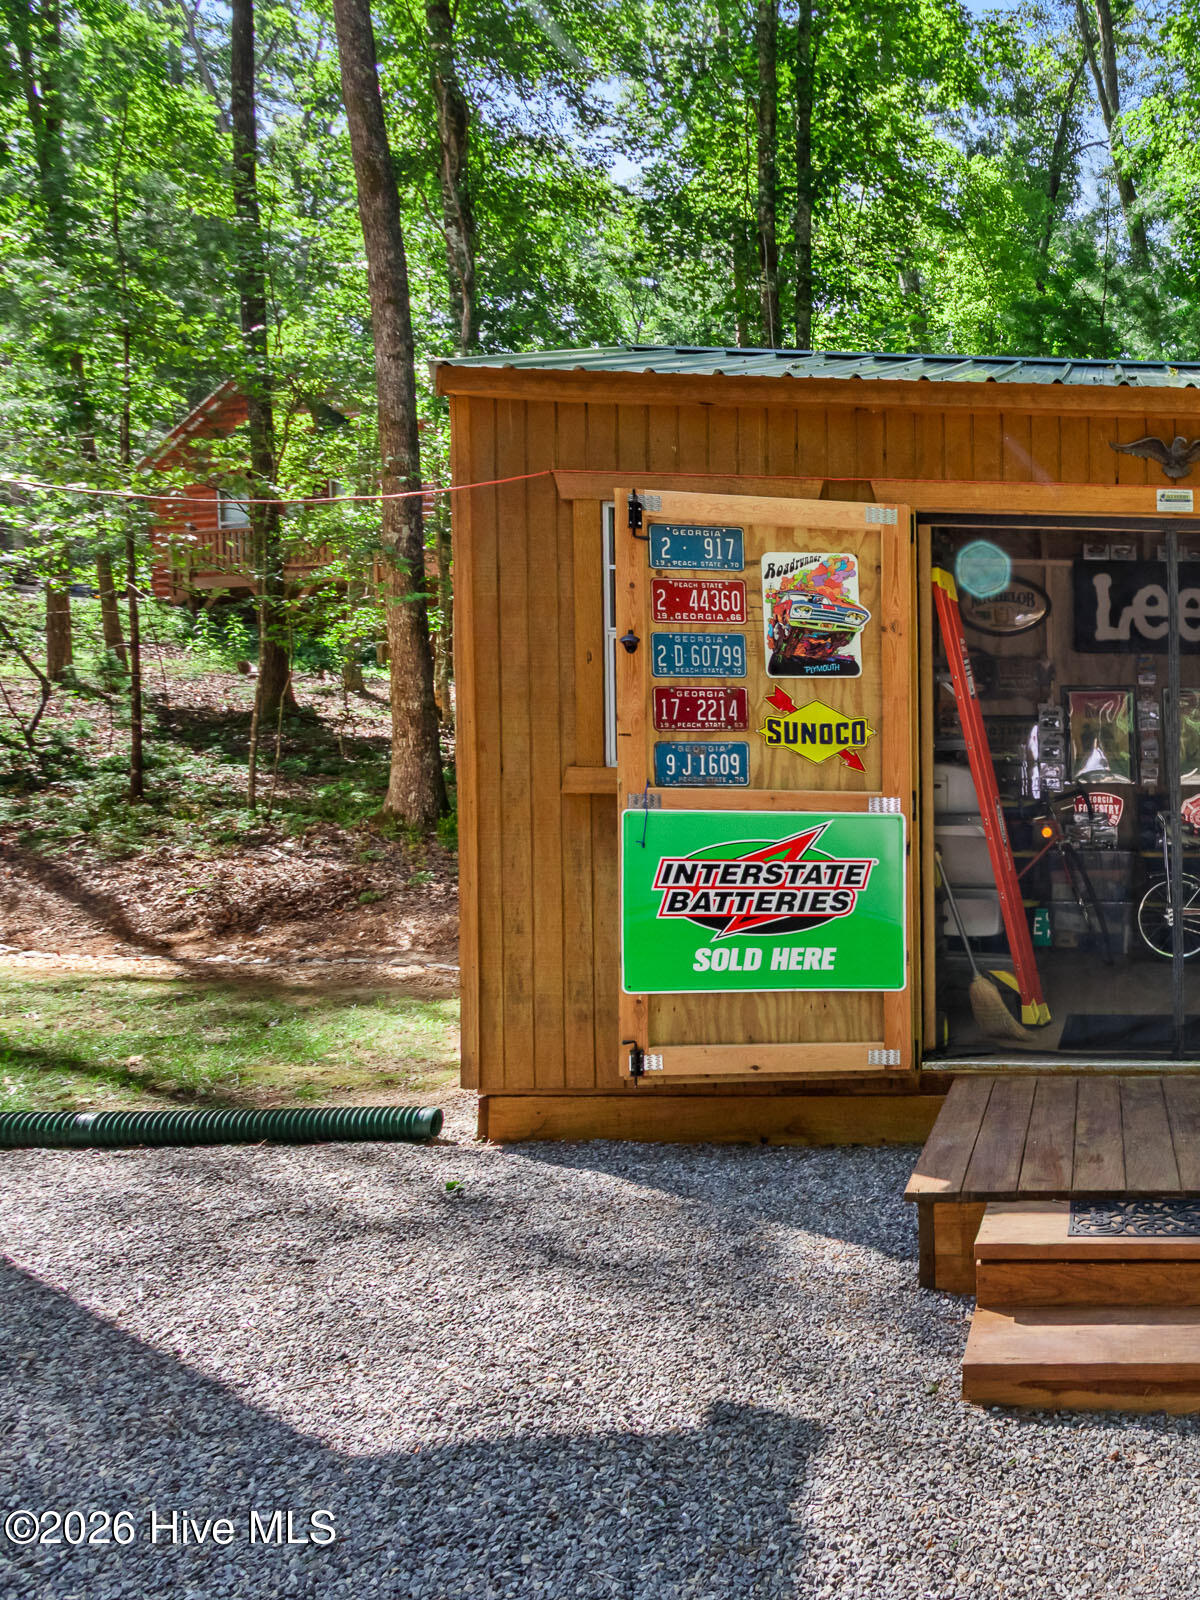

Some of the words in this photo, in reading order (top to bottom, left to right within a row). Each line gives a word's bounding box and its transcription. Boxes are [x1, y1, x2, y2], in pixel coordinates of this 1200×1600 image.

[672, 528, 721, 537] GEORGIA
[704, 538, 734, 560] 917
[764, 555, 822, 579] Roadrunner
[689, 589, 741, 612] 44360
[675, 612, 723, 620] GEORGIA
[730, 613, 742, 621] 66
[674, 635, 723, 643] GEORGIA
[803, 663, 841, 674] PLYMOUTH
[676, 690, 726, 698] GEORGIA
[661, 698, 679, 720] 17
[697, 699, 738, 721] 2214
[767, 719, 866, 745] SUNOCO
[677, 745, 726, 753] GEORGIA
[660, 863, 867, 885] INTERSTATE
[666, 891, 852, 913] BATTERIES
[692, 947, 763, 972] SOLD
[770, 947, 837, 971] HERE
